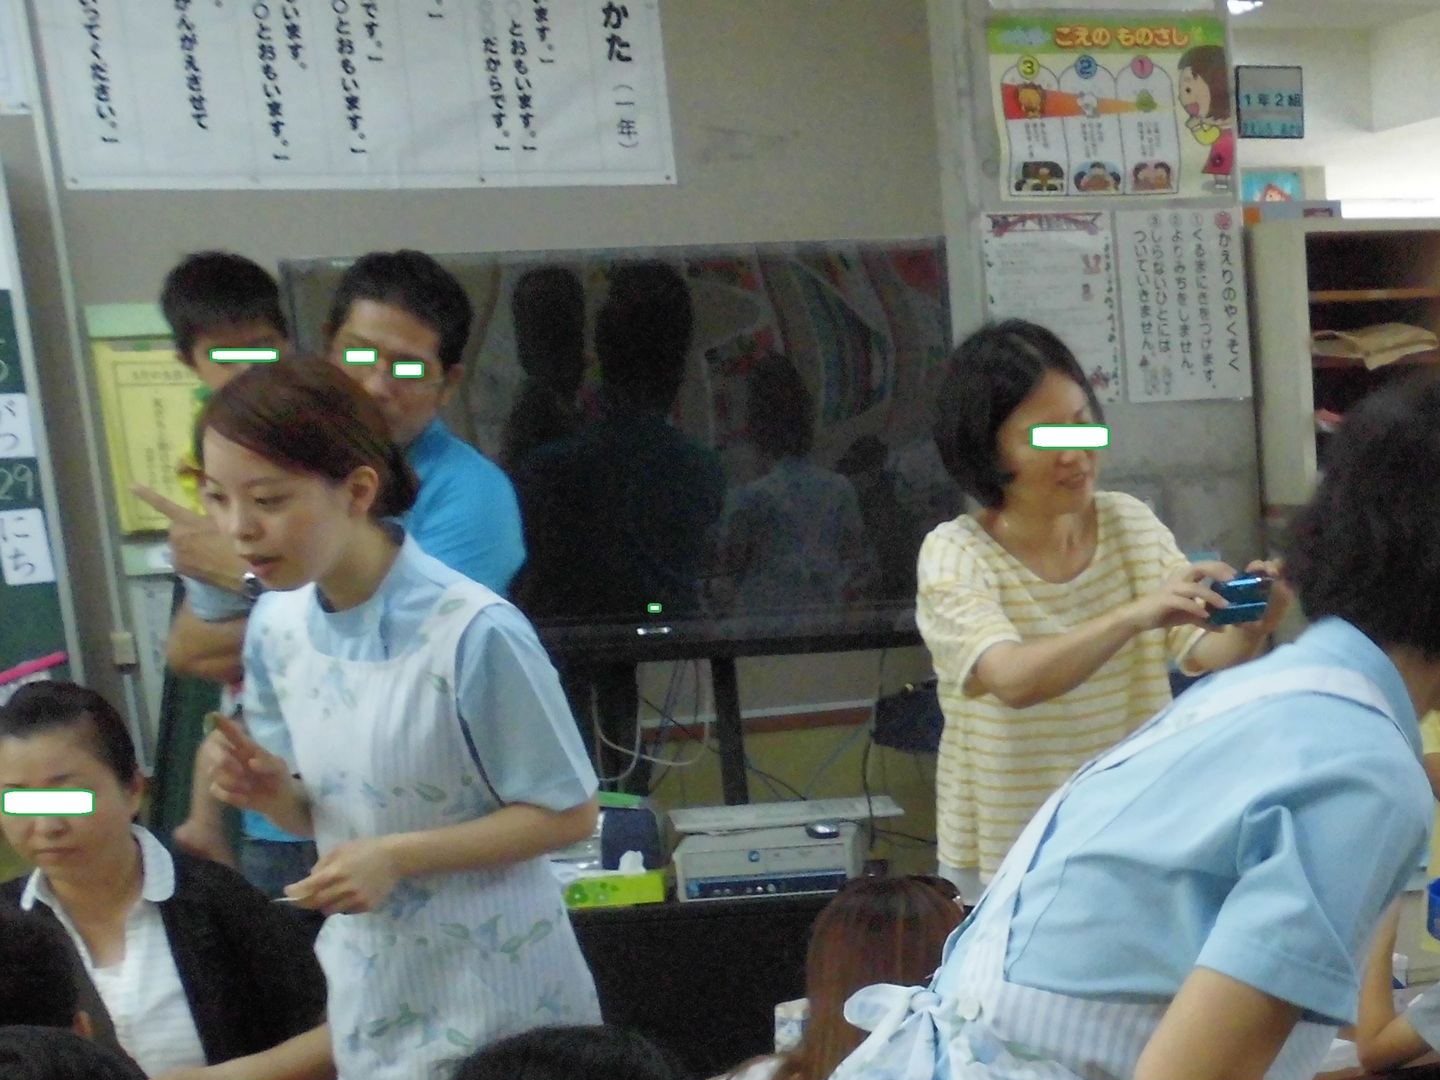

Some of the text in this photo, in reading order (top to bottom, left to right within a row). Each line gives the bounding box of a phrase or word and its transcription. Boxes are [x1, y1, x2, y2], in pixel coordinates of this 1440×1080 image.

[1054, 24, 1190, 48] こえの ものさし
